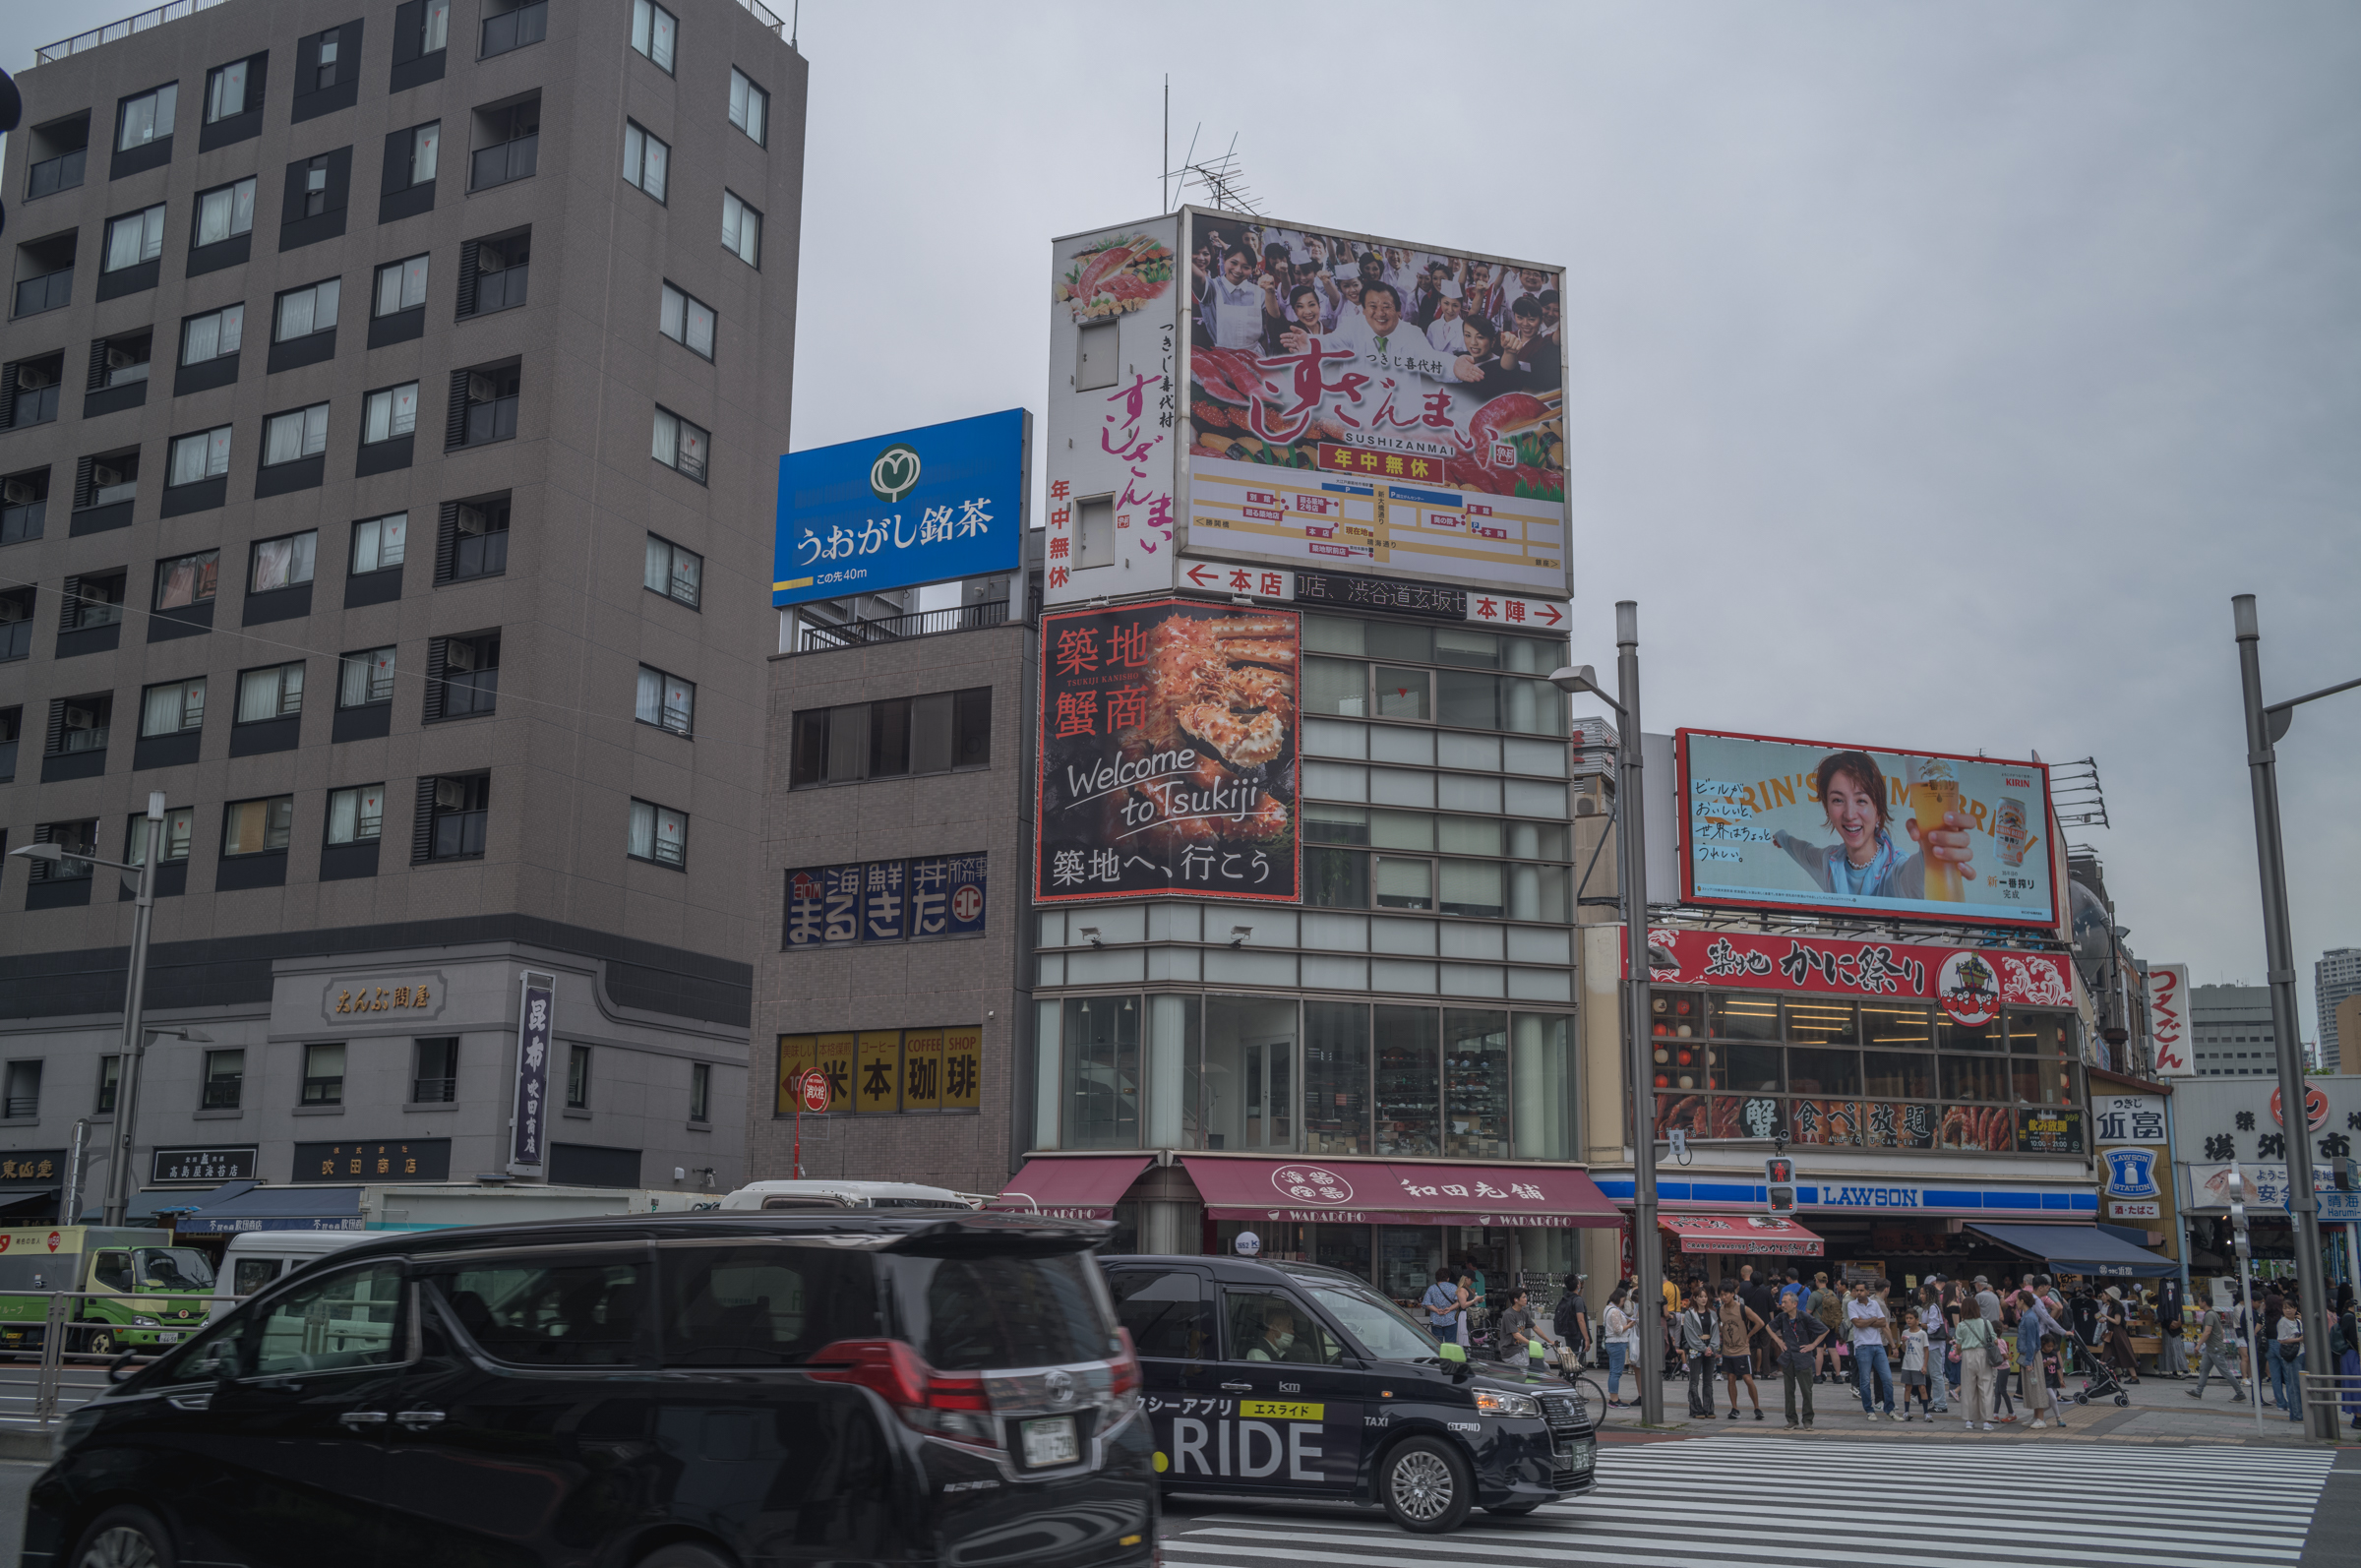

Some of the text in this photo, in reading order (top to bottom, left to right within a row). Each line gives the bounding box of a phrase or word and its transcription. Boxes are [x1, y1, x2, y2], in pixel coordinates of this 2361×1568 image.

[1365, 352, 1443, 374] つきじ喜代村
[1159, 324, 1175, 429] つきじ喜代村
[1250, 337, 1500, 450] すしざんまい
[1345, 432, 1454, 455] SUSHIZANMAI
[1101, 374, 1174, 555] すしざんまい
[1334, 449, 1429, 478] 年中無休
[797, 497, 995, 567] うおがし銘茶
[1049, 479, 1070, 589] 年中無休
[1308, 527, 1330, 537] 本店
[1345, 525, 1368, 537] 現在地
[1366, 538, 1397, 549] 晴海通り
[817, 568, 868, 585] この先40m
[1229, 569, 1283, 597] 本店
[1477, 597, 1526, 624] 本陣
[1056, 622, 1149, 677] 築地
[1066, 672, 1139, 687] TSUKIJI KANISHO
[1055, 685, 1149, 740] 蟹商
[1067, 749, 1195, 798] Welcome
[2006, 778, 2030, 789] KIRIN
[1695, 778, 1744, 798] ビールが
[1120, 775, 1259, 826] to Tsukiji
[1695, 802, 1752, 819] おいしいと、
[1695, 822, 1772, 842] 世界はちょっと
[1699, 842, 1743, 863] うれしい。
[1053, 843, 1270, 886] 築地へ、行こう
[825, 859, 947, 896] 海鮮丼
[788, 888, 947, 944] まるきた
[1705, 937, 1925, 995] 築地 かに祭り
[525, 998, 547, 1072] 昆布
[907, 1036, 976, 1053] COFFEE SHOP
[782, 1044, 816, 1058] 美味しい
[861, 1042, 896, 1054] コーヒー
[822, 1054, 977, 1103] 米本珈琲
[807, 1084, 824, 1100] 消火栓
[2113, 1098, 2143, 1109] つきじ
[1745, 1097, 1781, 1139] 蟹
[1793, 1099, 1931, 1139] 食べ放題
[2028, 1118, 2068, 1132] 飲み放題
[2096, 1111, 2164, 1139] 近富
[1793, 1131, 1826, 1144] CRAB
[0, 1159, 54, 1178] 東山堂
[322, 1158, 417, 1176] 吹田商店
[2111, 1154, 2149, 1164] LAWSON
[169, 1165, 238, 1178] 高島屋海苔店
[1400, 1178, 1545, 1201] 和田老舗
[1823, 1187, 1917, 1208] LAWSON
[2114, 1182, 2150, 1192] STATION
[2114, 1205, 2154, 1216] 酒・たばこ
[2328, 1194, 2359, 1208] 晴海
[0, 1305, 25, 1315] ループ
[1279, 1380, 1302, 1393] km
[1254, 1404, 1309, 1417] エスライド
[1363, 1416, 1389, 1427] TAXI
[1173, 1416, 1326, 1482] RIDE
